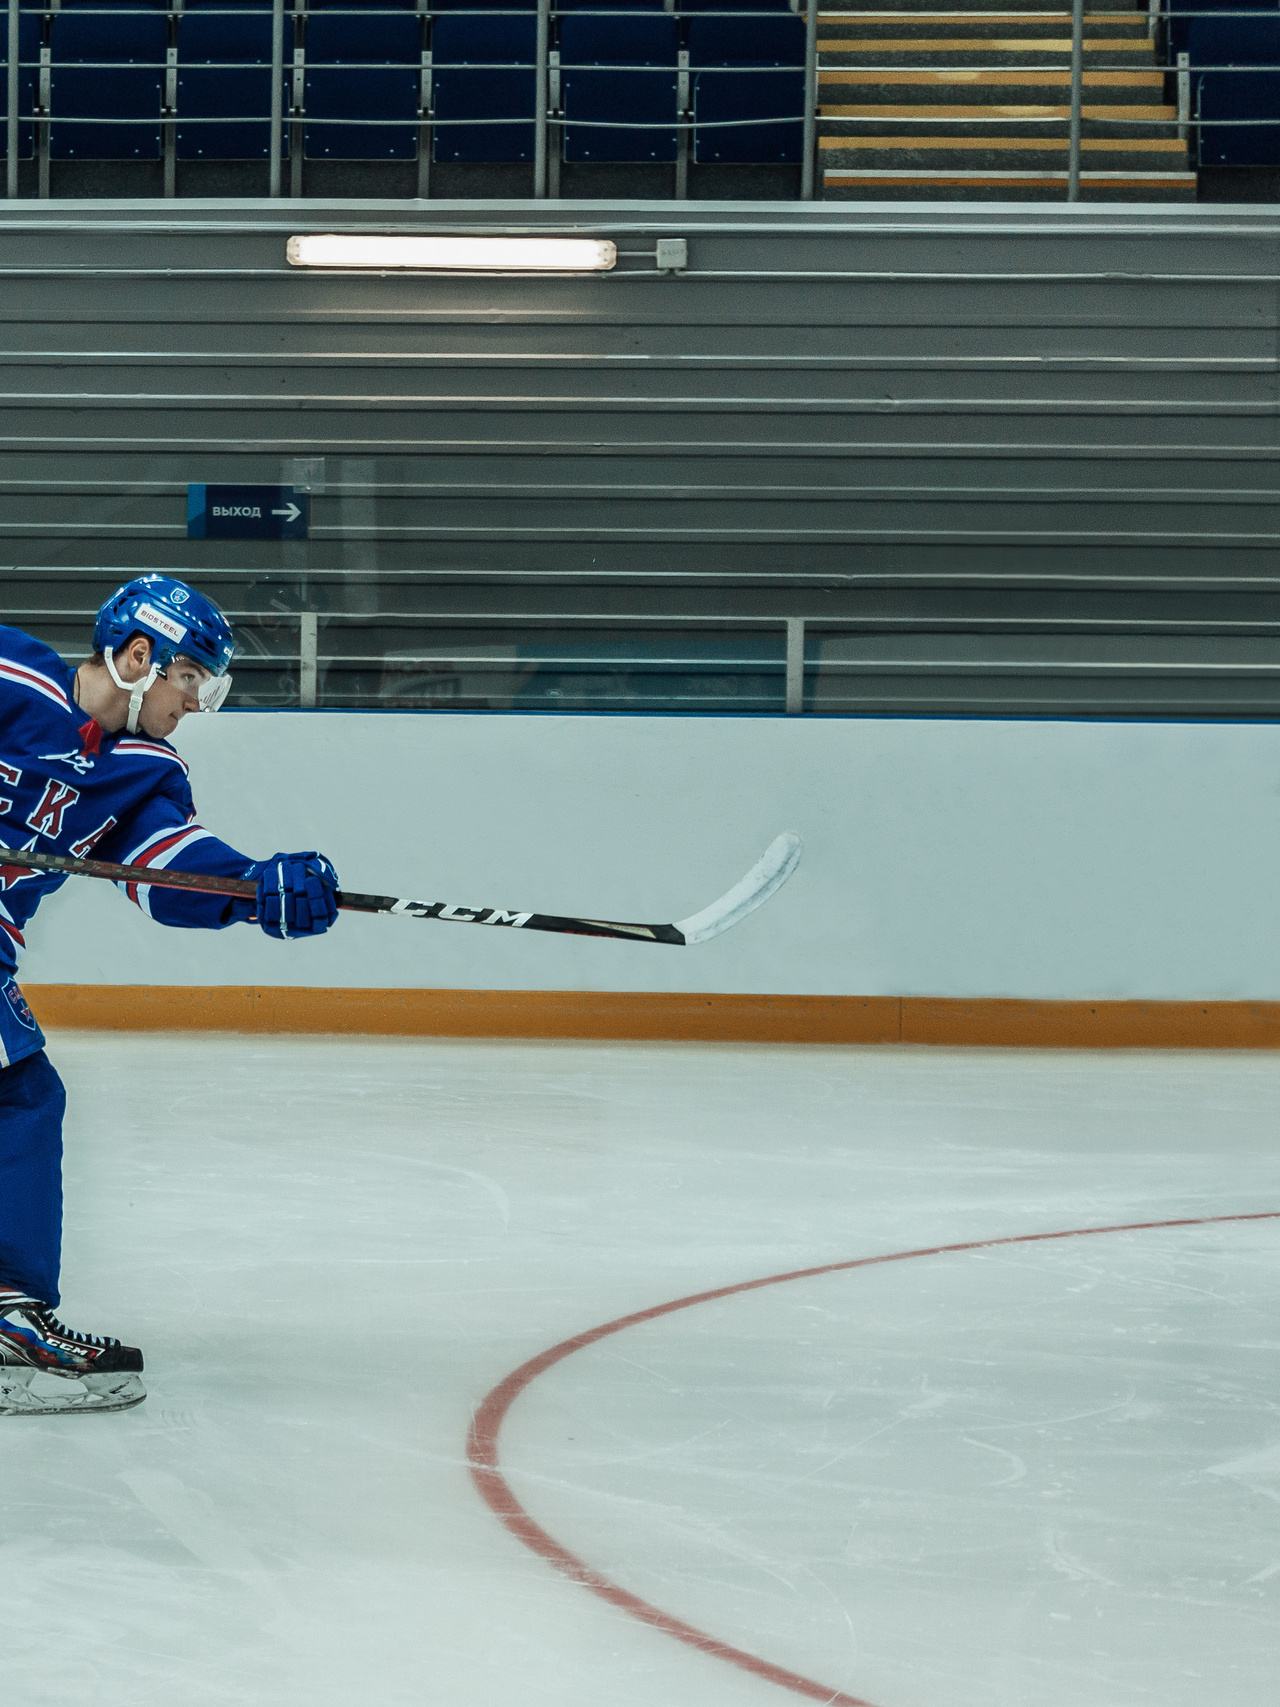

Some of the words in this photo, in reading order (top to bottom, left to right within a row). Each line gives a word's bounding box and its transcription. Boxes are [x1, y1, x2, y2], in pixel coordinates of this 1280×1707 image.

[212, 506, 262, 518] ВЫХОД
[141, 610, 179, 637] BIOSTEEL
[389, 899, 534, 928] CCM
[46, 1337, 88, 1356] CCM
